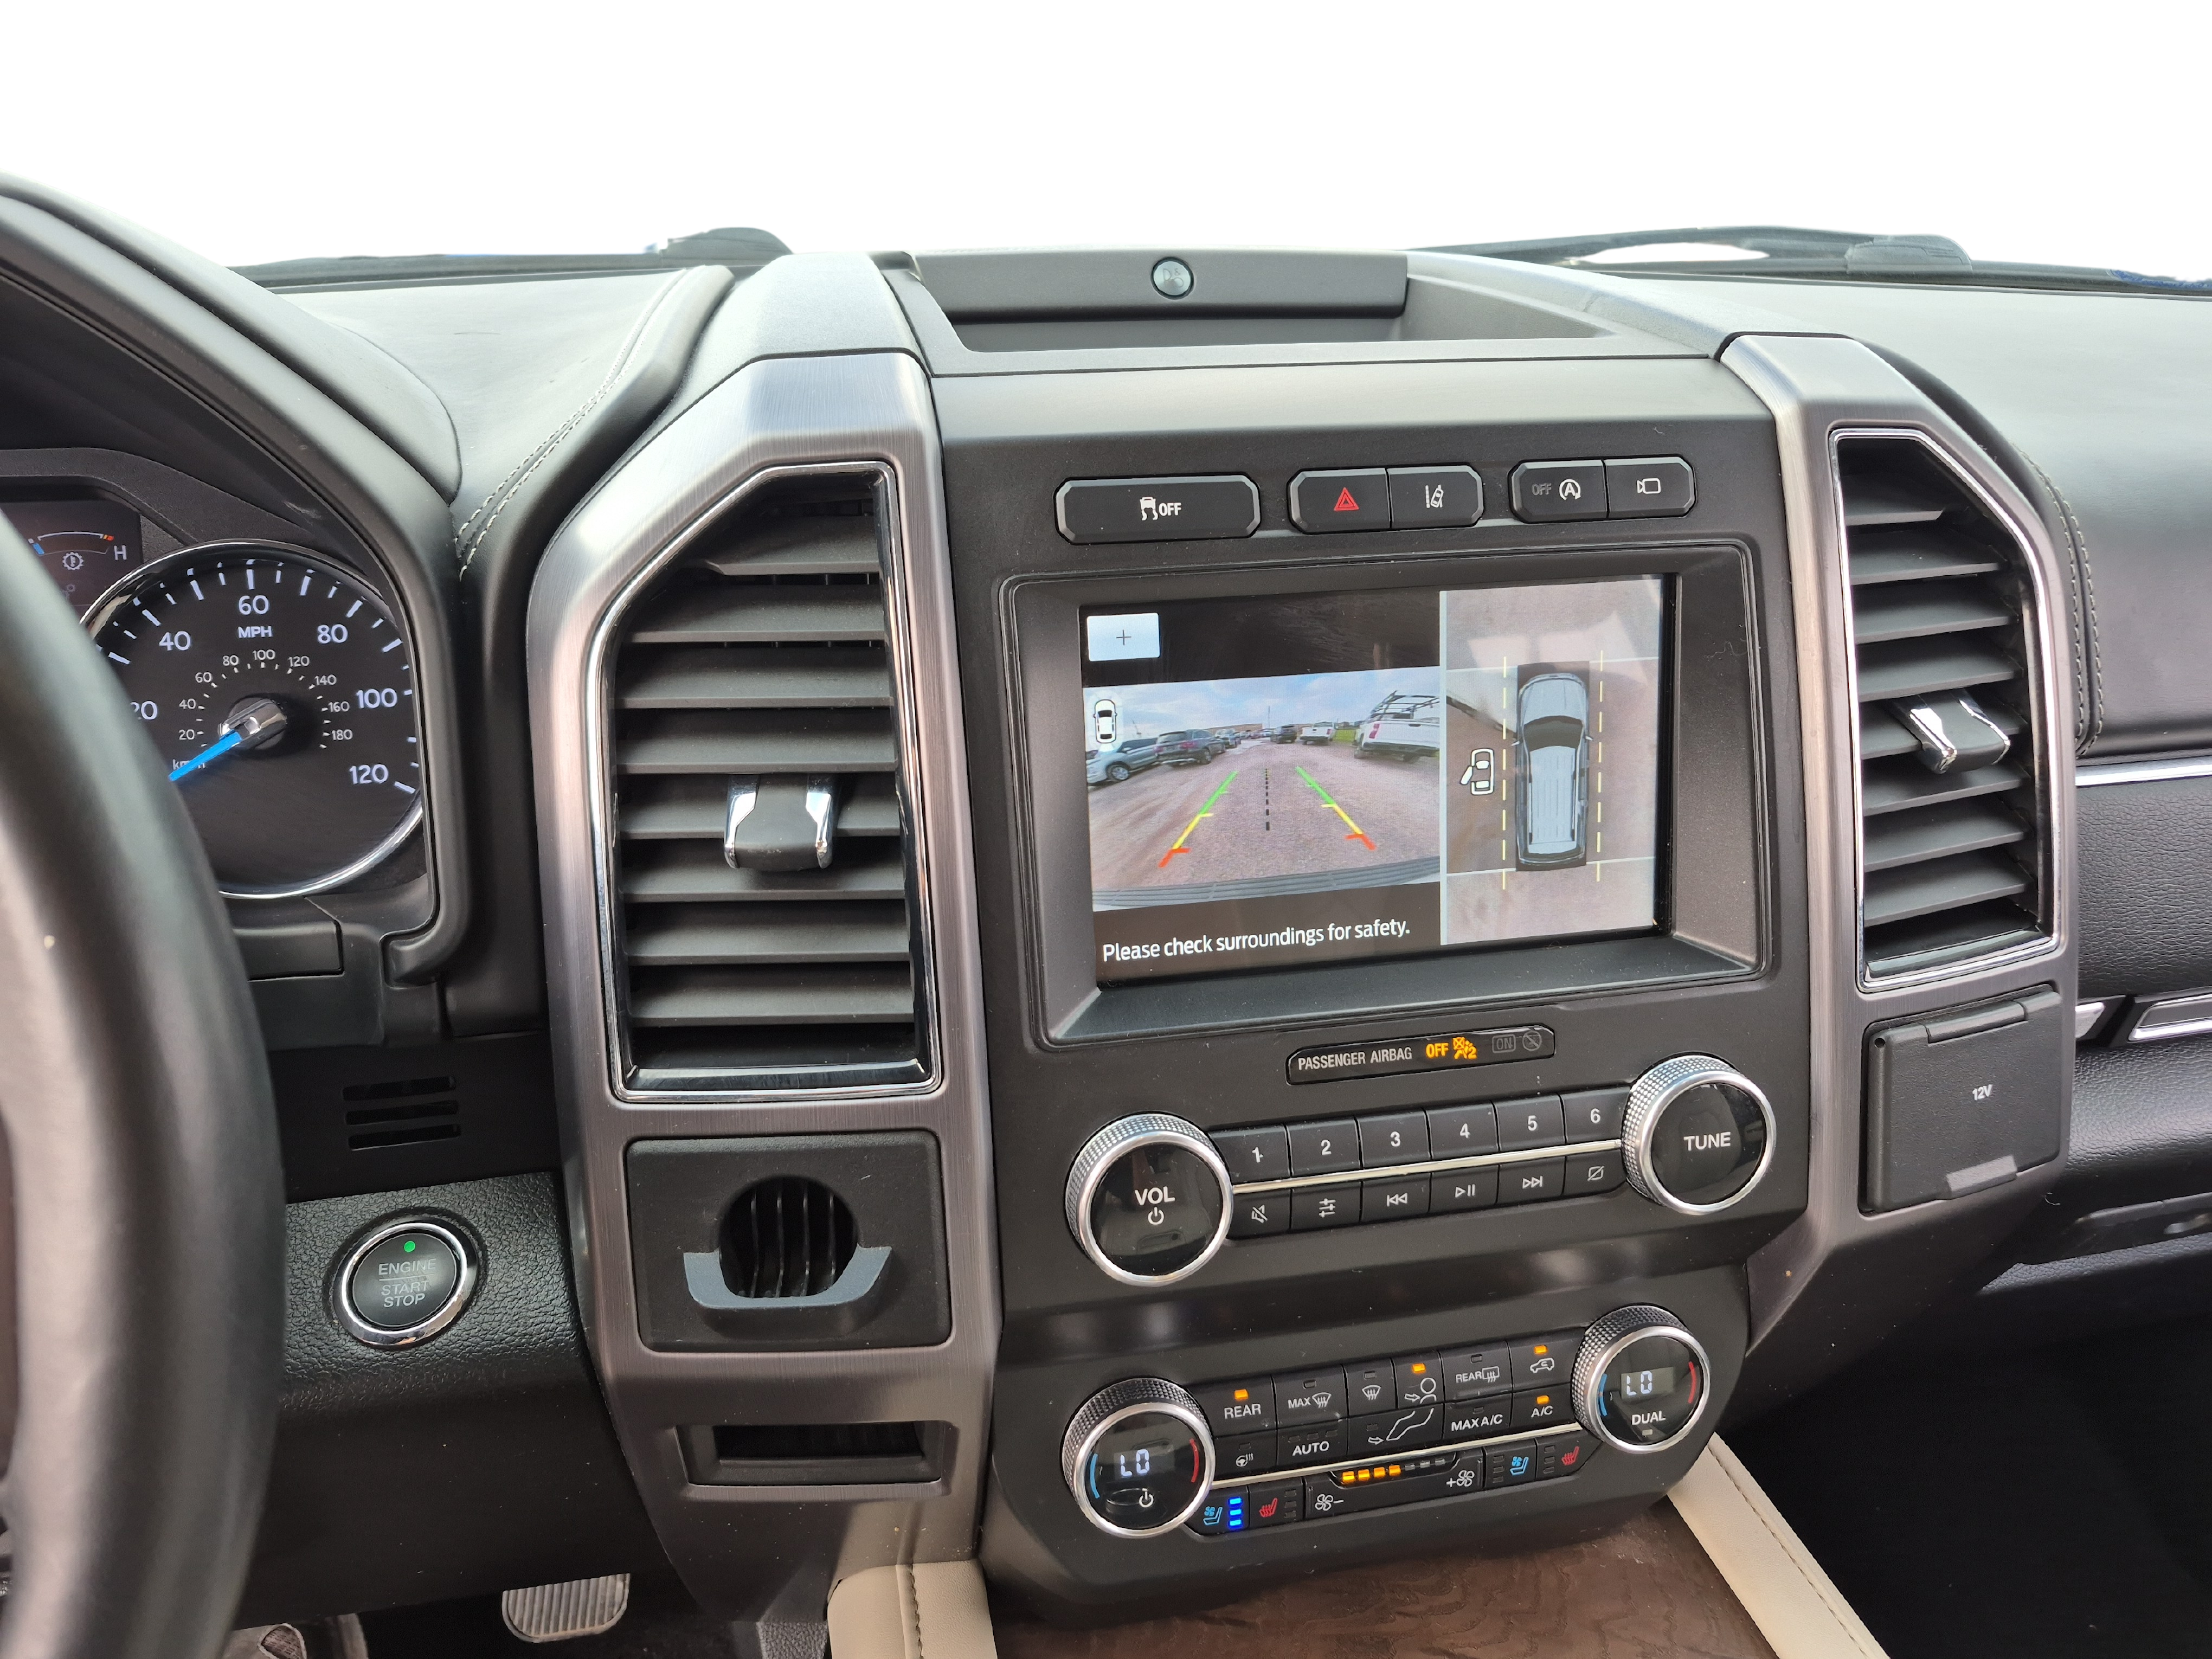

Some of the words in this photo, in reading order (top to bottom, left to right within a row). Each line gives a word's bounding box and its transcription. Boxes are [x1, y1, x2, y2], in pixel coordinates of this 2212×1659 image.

[1532, 483, 1552, 496] OFF
[1158, 502, 1181, 518] OFF
[113, 545, 127, 561] H
[238, 595, 269, 615] 60
[237, 626, 273, 639] MPH
[317, 623, 349, 644] 80
[159, 631, 191, 651] 40
[222, 654, 240, 666] 80
[252, 649, 276, 661] 100
[288, 655, 310, 667] 120
[195, 672, 213, 684] 60
[314, 674, 337, 686] 140
[178, 698, 196, 710] 40
[328, 700, 350, 712] 160
[356, 689, 398, 709] 100
[178, 729, 195, 741] 20
[331, 729, 353, 741] 180
[349, 764, 389, 786] 120
[1103, 942, 1161, 962] Please
[1163, 934, 1213, 957] check
[1216, 927, 1324, 952] surroundings
[1327, 923, 1352, 941] for
[1354, 918, 1411, 938] safety.
[1496, 1037, 1513, 1050] ON
[1298, 1050, 1366, 1071] PASSENGER
[1370, 1046, 1412, 1064] AIRBAG
[1425, 1042, 1450, 1059] OFF
[1971, 1084, 1994, 1101] 12V
[1527, 1115, 1538, 1132] 5
[1590, 1108, 1601, 1124] 6
[1390, 1131, 1401, 1147] 3
[1459, 1123, 1471, 1139] 4
[1320, 1139, 1332, 1156] 2
[1683, 1130, 1732, 1151] TUNE
[1251, 1147, 1264, 1163] 1
[1134, 1186, 1175, 1206] VOL
[378, 1258, 437, 1275] ENGINE
[381, 1280, 430, 1296] START
[383, 1293, 426, 1308] STOP
[1455, 1371, 1482, 1384] REAR
[1626, 1369, 1653, 1397] LO
[1224, 1403, 1262, 1419] REAR
[1288, 1397, 1311, 1409] MAX
[1531, 1405, 1554, 1418] A/C
[1631, 1410, 1666, 1426] DUAL
[1451, 1418, 1479, 1432] MAX
[1480, 1413, 1503, 1427] A/C
[1292, 1441, 1330, 1457] AUTO
[1120, 1449, 1150, 1477] LO
